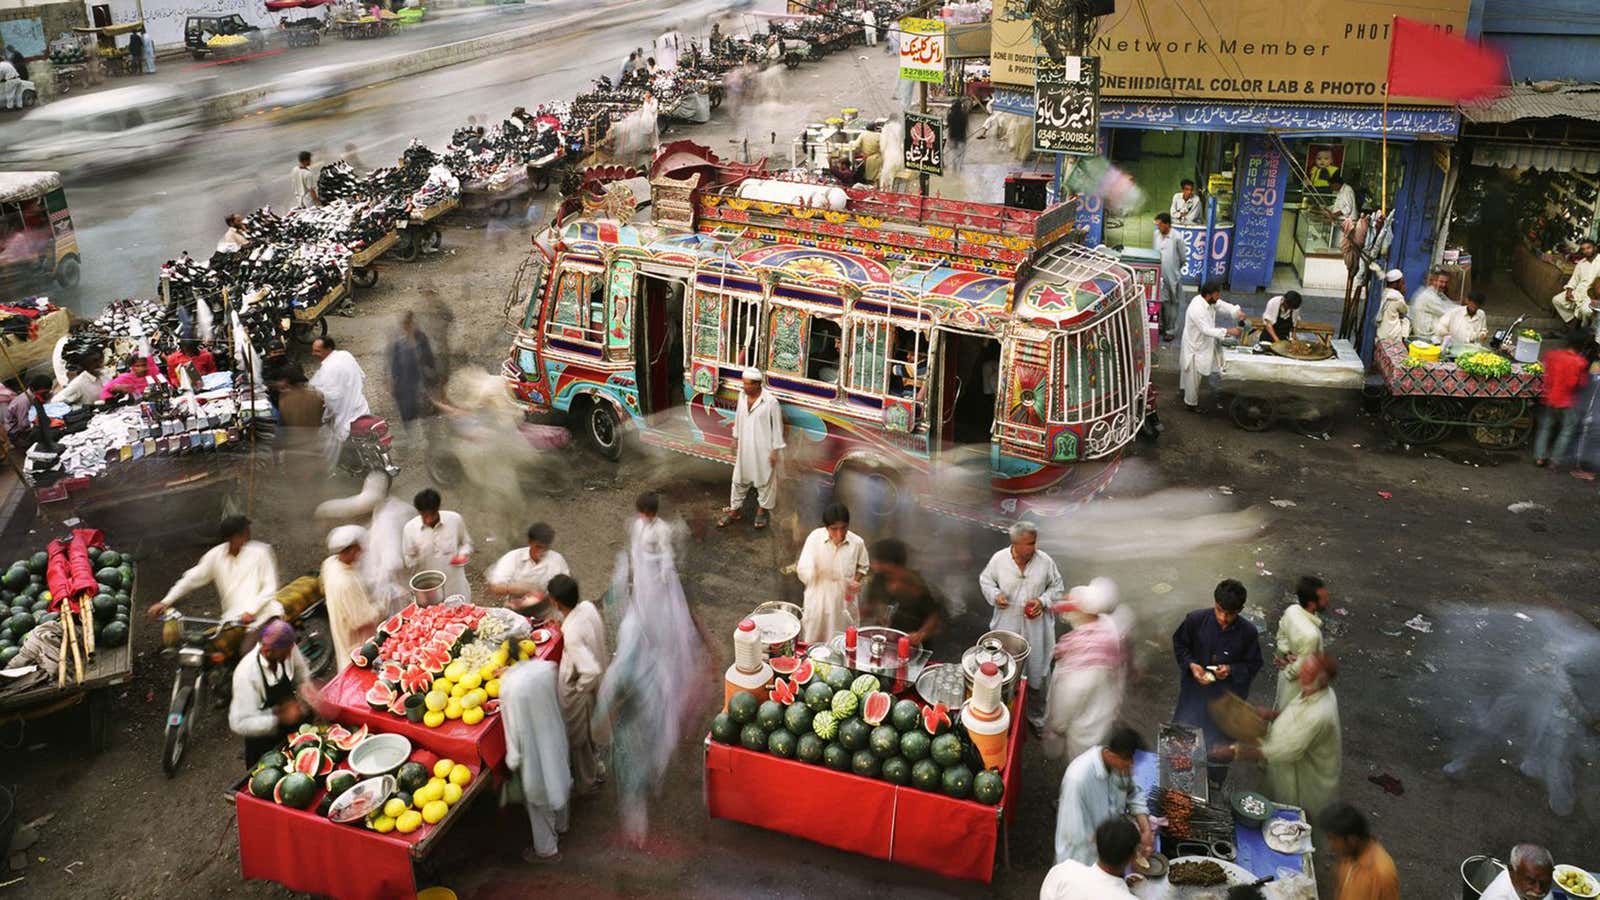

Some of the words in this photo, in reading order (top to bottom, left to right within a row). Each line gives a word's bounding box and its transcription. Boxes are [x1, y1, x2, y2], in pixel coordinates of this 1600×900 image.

[1097, 37, 1207, 53] Network
[1220, 39, 1330, 56] Member
[1015, 54, 1036, 63] DIGITA
[1145, 76, 1204, 91] DIGITAL
[1210, 78, 1263, 93] COLOR
[1268, 80, 1299, 93] LAB
[1304, 81, 1314, 94] &
[1320, 81, 1375, 96] PHOTO
[1037, 129, 1095, 144] 0346-3001854
[1251, 187, 1277, 206] 50
[1192, 230, 1229, 261] 50
